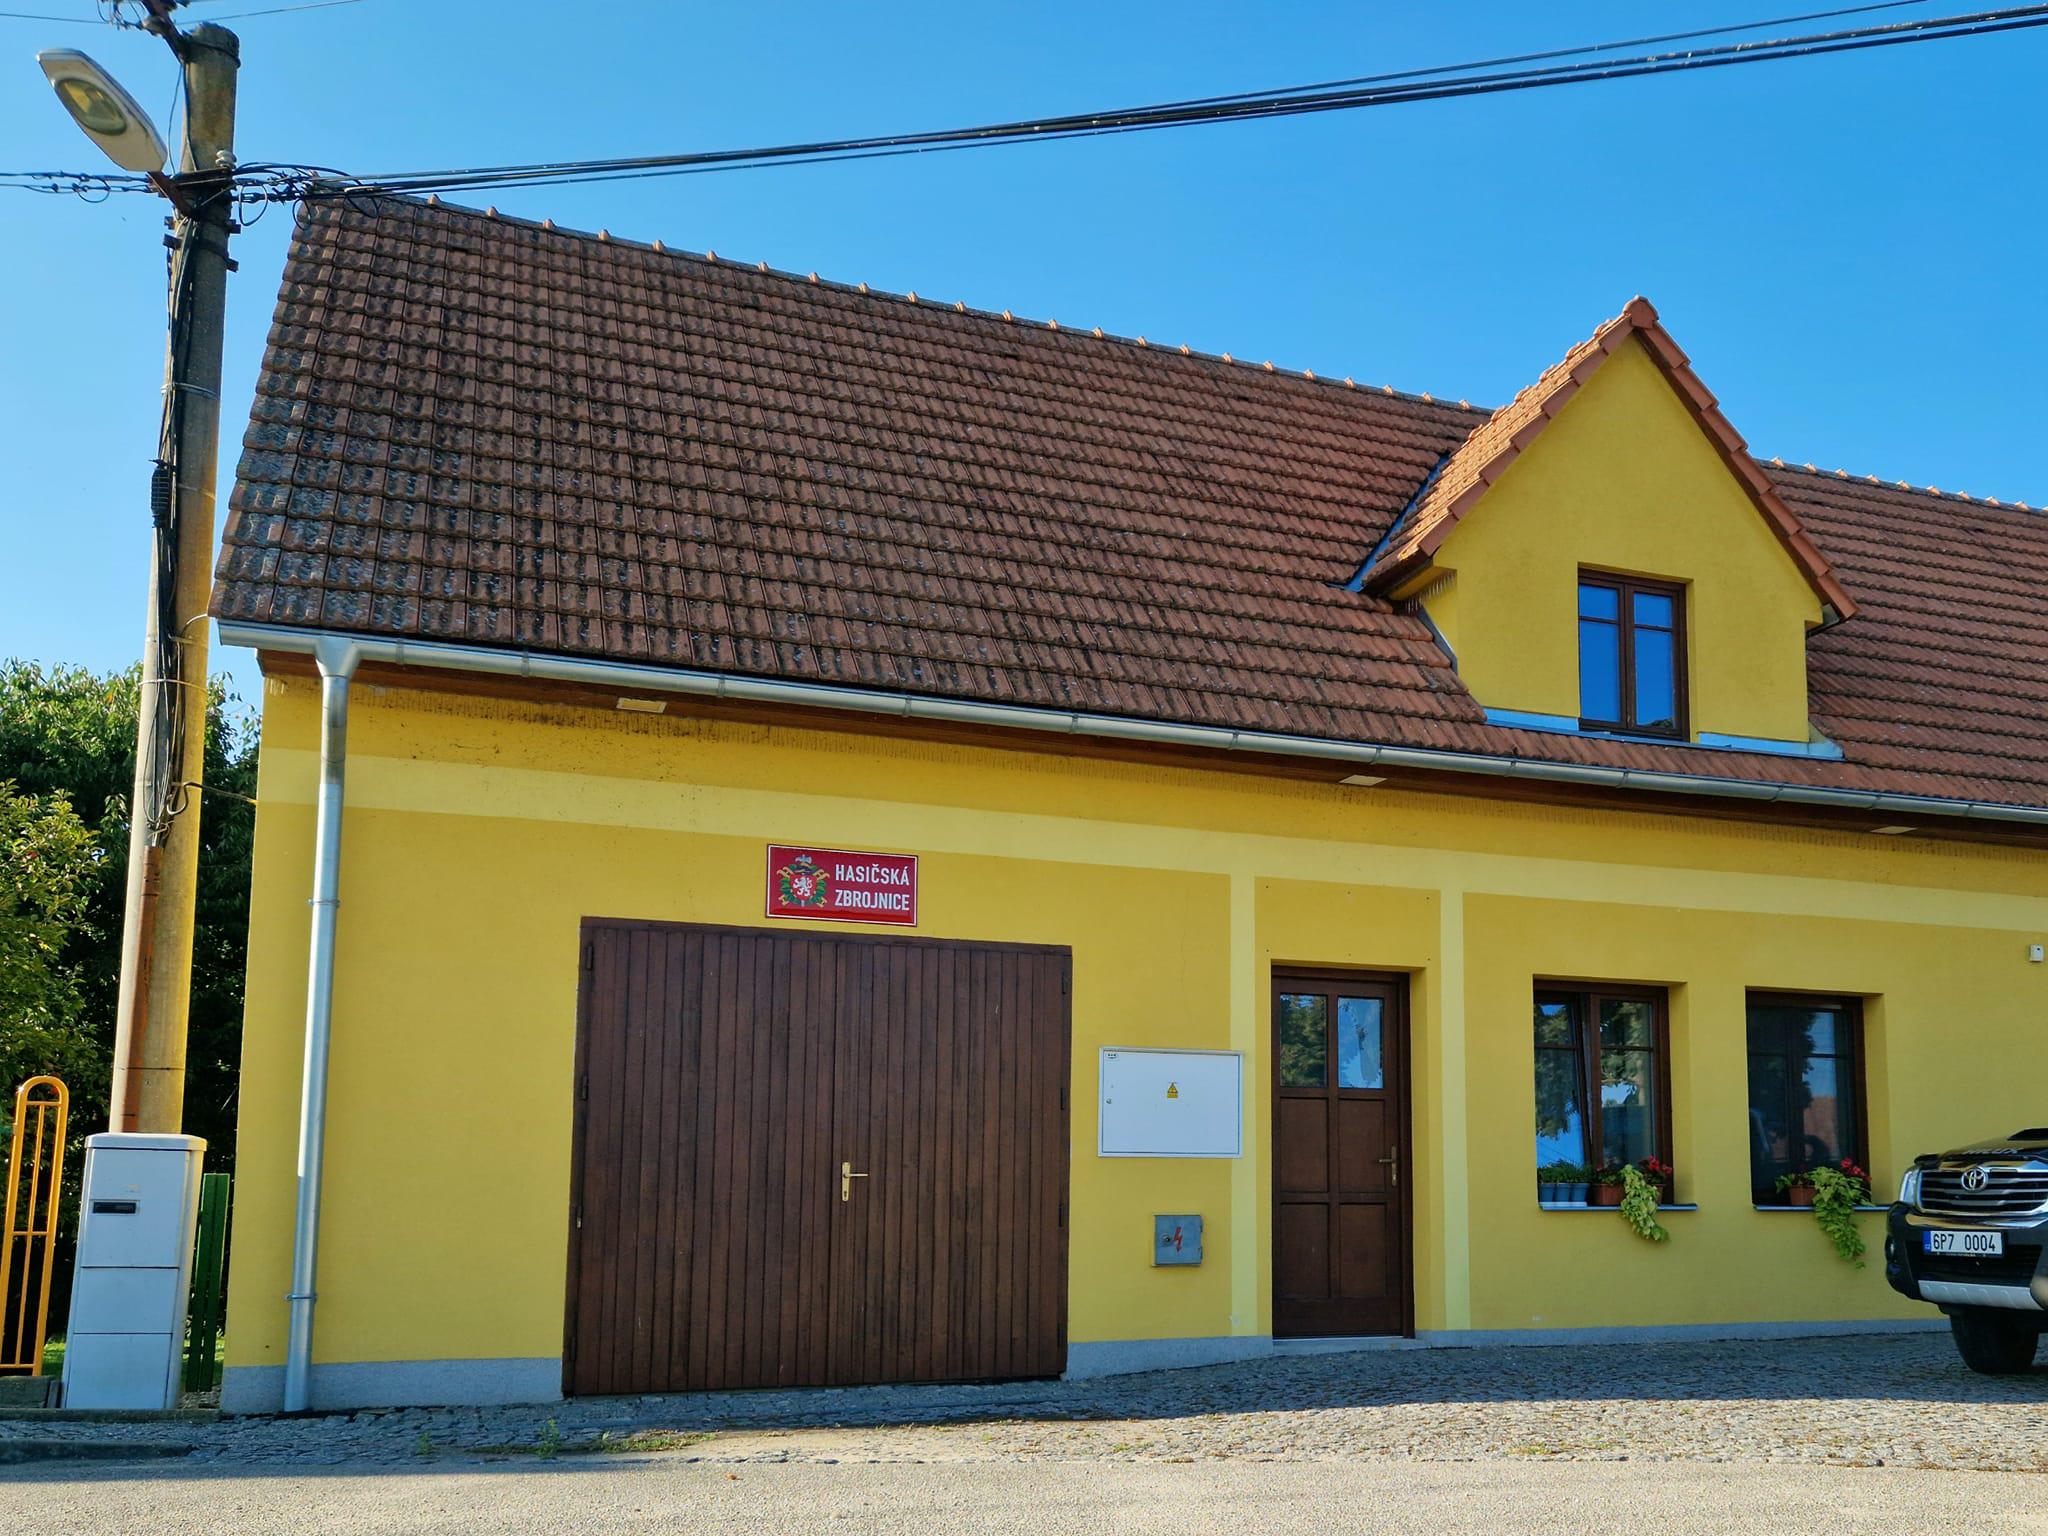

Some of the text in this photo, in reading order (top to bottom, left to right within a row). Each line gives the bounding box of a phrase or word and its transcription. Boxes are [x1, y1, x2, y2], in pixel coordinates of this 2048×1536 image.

[835, 864, 910, 886] HASIČSKÁ
[835, 889, 910, 911] ZBROJNICE
[1933, 1233, 1996, 1252] 6P7 0004
